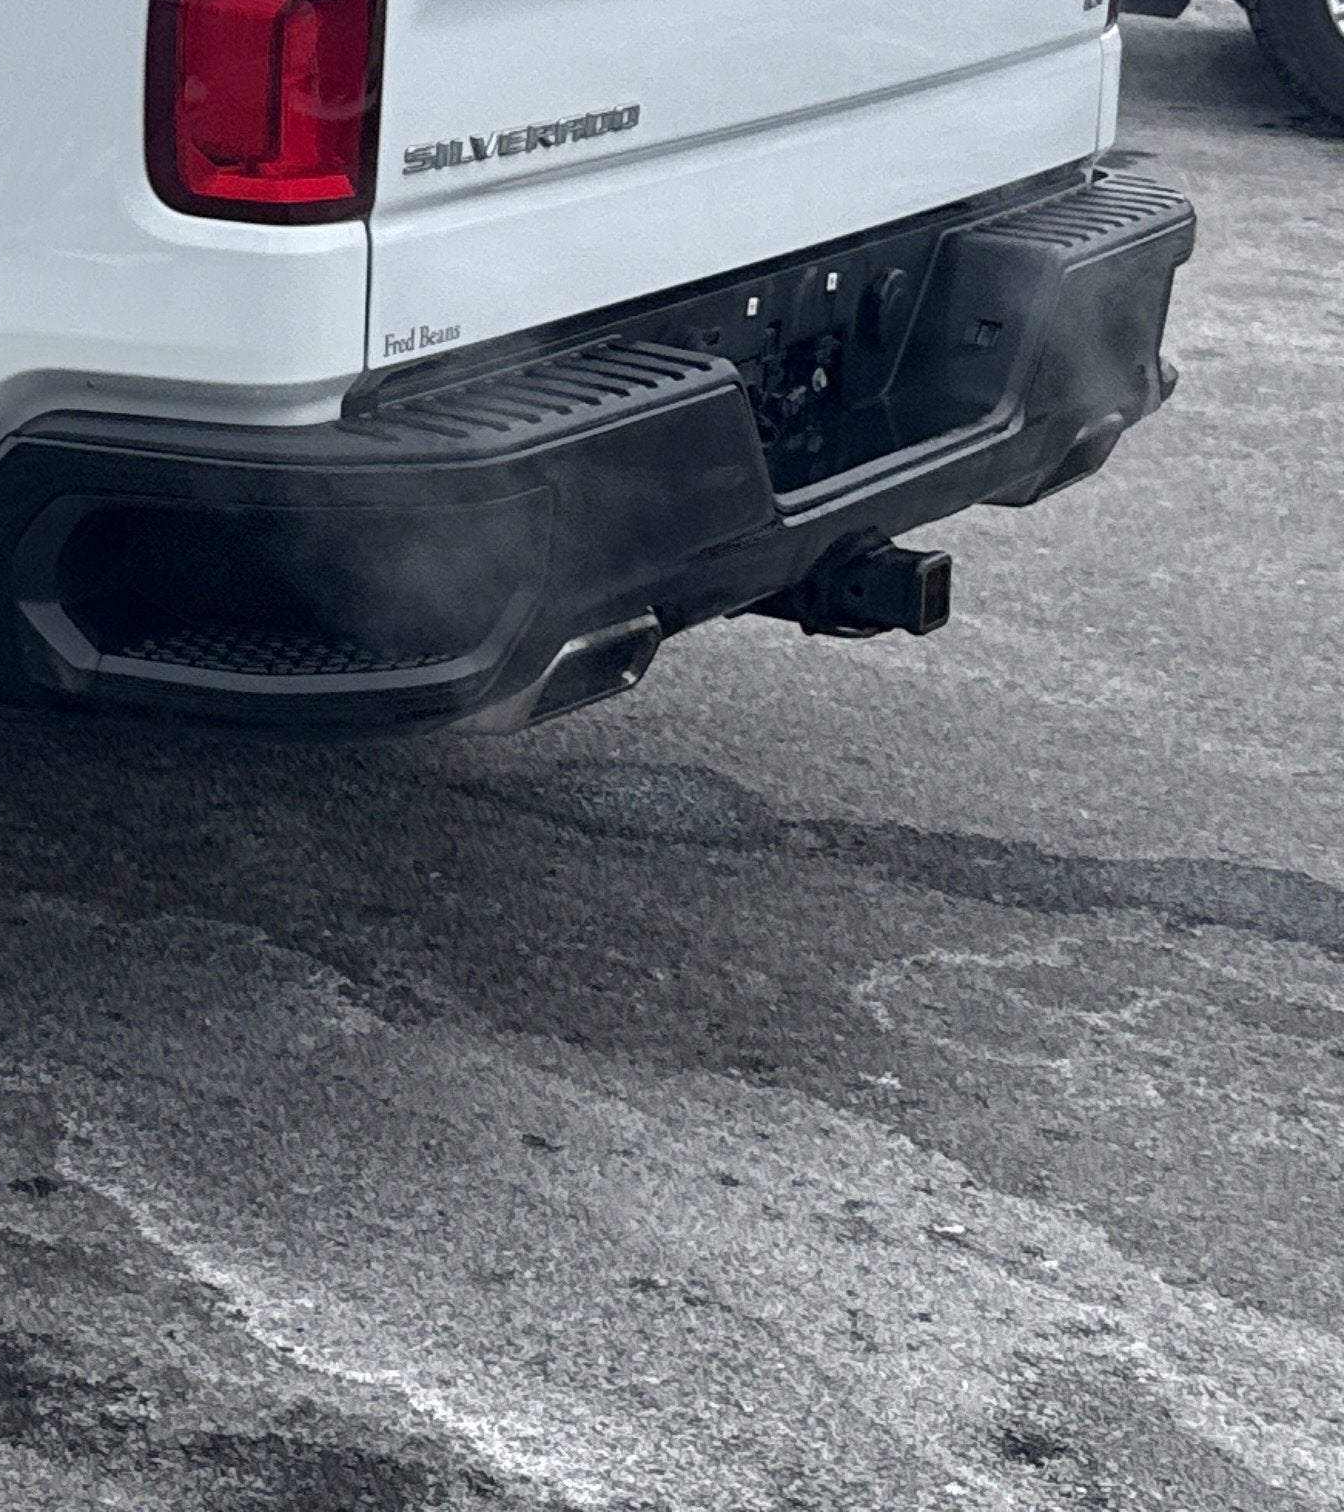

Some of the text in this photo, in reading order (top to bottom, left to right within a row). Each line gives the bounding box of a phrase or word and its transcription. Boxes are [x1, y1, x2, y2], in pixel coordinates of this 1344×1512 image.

[402, 104, 641, 175] SILVERADO
[383, 324, 461, 357] Fred Beans
